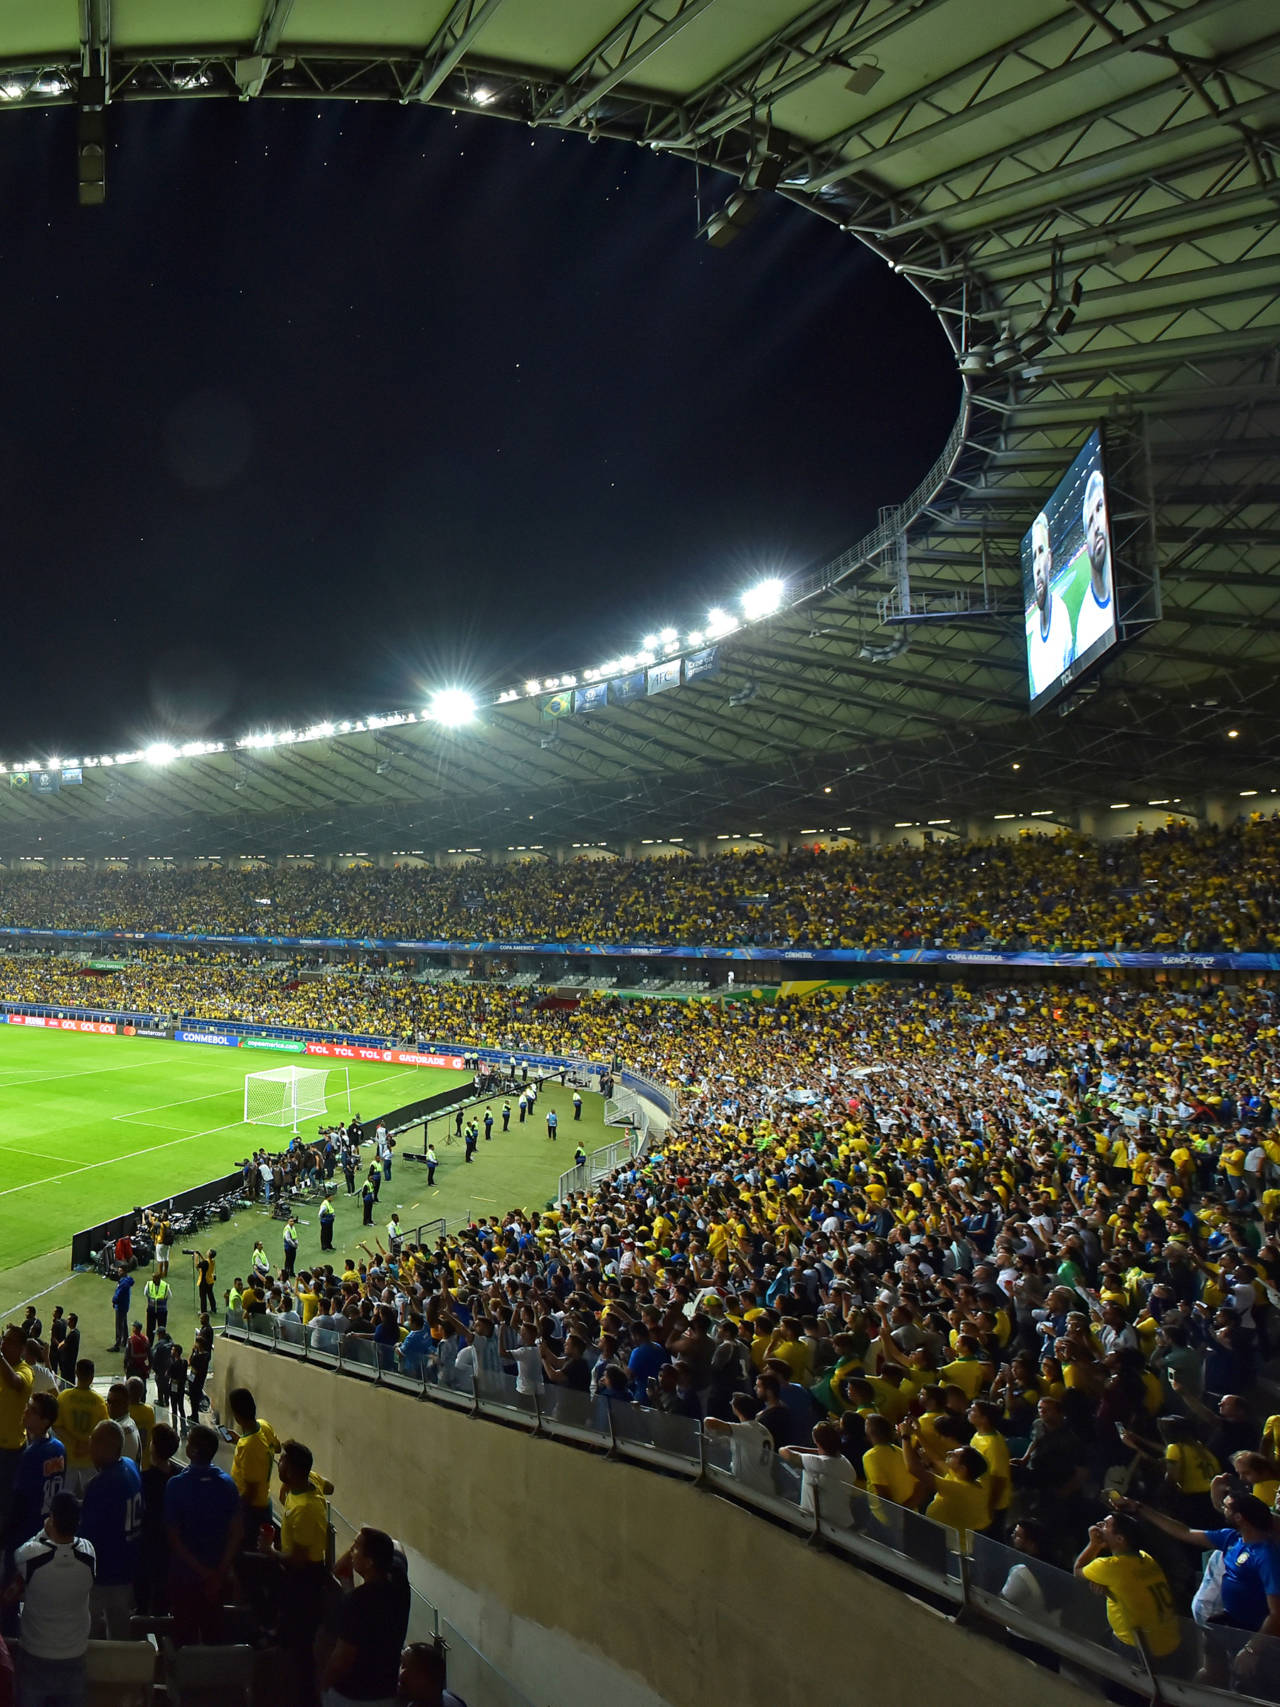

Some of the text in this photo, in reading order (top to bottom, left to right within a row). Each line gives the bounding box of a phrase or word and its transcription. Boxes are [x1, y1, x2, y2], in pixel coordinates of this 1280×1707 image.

[946, 953, 1003, 962] COPA AMERICA
[62, 1021, 115, 1034] GOL GOL GOL
[137, 1029, 166, 1037] mastercard
[183, 1033, 230, 1045] CONMEBOL
[247, 1040, 299, 1050] copaamerica.com
[309, 1046, 380, 1059] TCL TCL TCL
[383, 1051, 461, 1068] G GATORADE G
